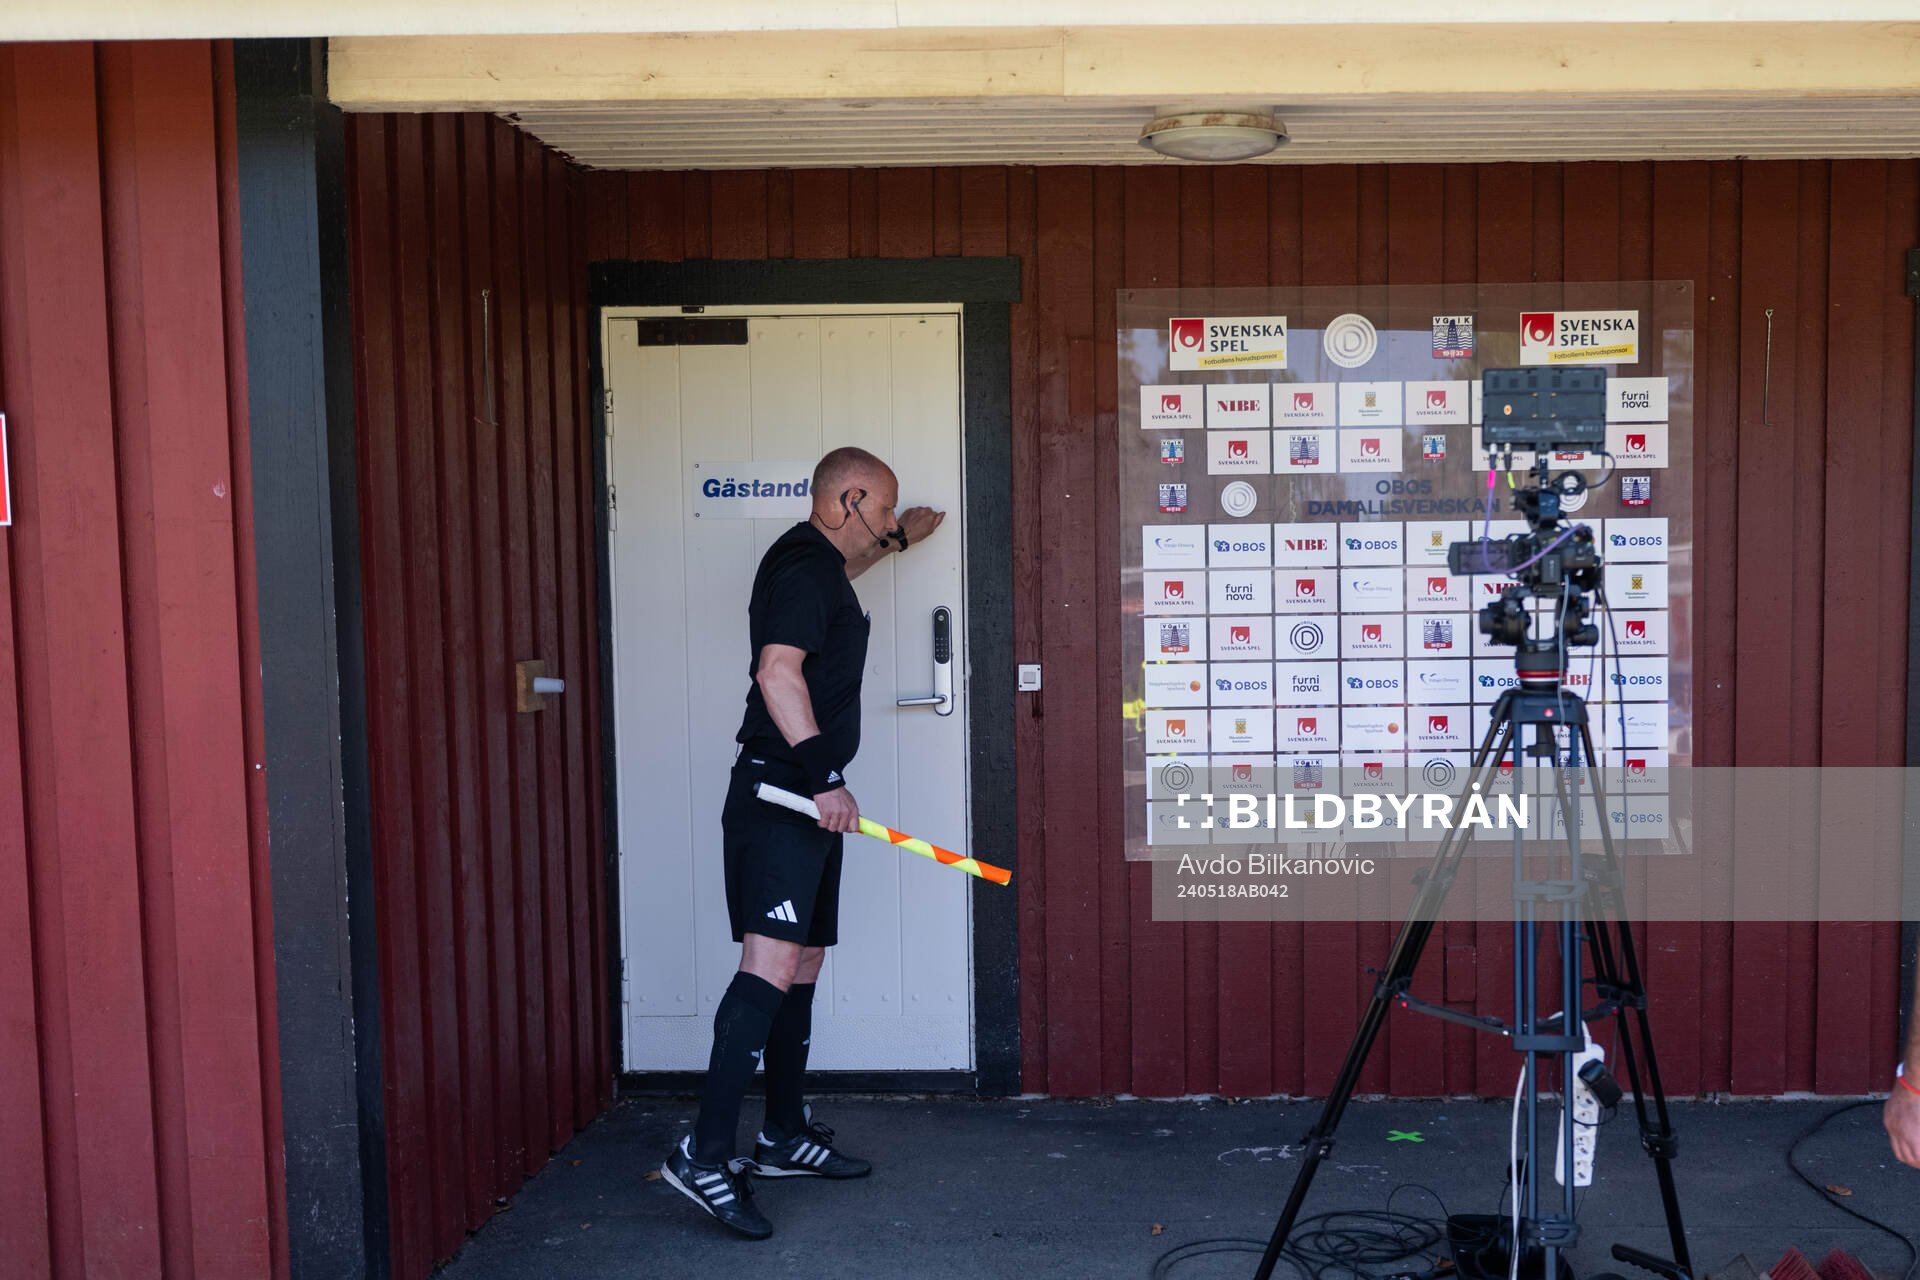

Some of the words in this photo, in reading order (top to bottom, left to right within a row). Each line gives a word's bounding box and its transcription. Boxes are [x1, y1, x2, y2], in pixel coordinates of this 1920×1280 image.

[1560, 319, 1635, 332] SVENSKA
[1210, 324, 1284, 338] SVENSKA
[1560, 334, 1599, 347] SPEL
[1210, 340, 1249, 352] SPEL
[1554, 351, 1584, 360] Fotbollens
[1586, 347, 1628, 358] huvudsponsor
[1622, 391, 1649, 400] furni
[1217, 400, 1260, 412] NIBE
[703, 478, 813, 497] Gästand
[1376, 479, 1432, 495] OBOS
[1309, 499, 1499, 515] DAMALLSVENSKAN
[1233, 542, 1266, 551] OBOS
[1285, 539, 1328, 551] NIBE
[1365, 540, 1397, 550] OBOS
[1629, 537, 1662, 546] OBOS
[1225, 584, 1252, 593] furni
[1292, 675, 1319, 685] furni
[1366, 679, 1399, 689] OBOS
[1498, 678, 1520, 687] OBO
[1629, 676, 1662, 685] OBOS
[1235, 681, 1267, 690] OBOS
[1630, 814, 1662, 823] OBOS
